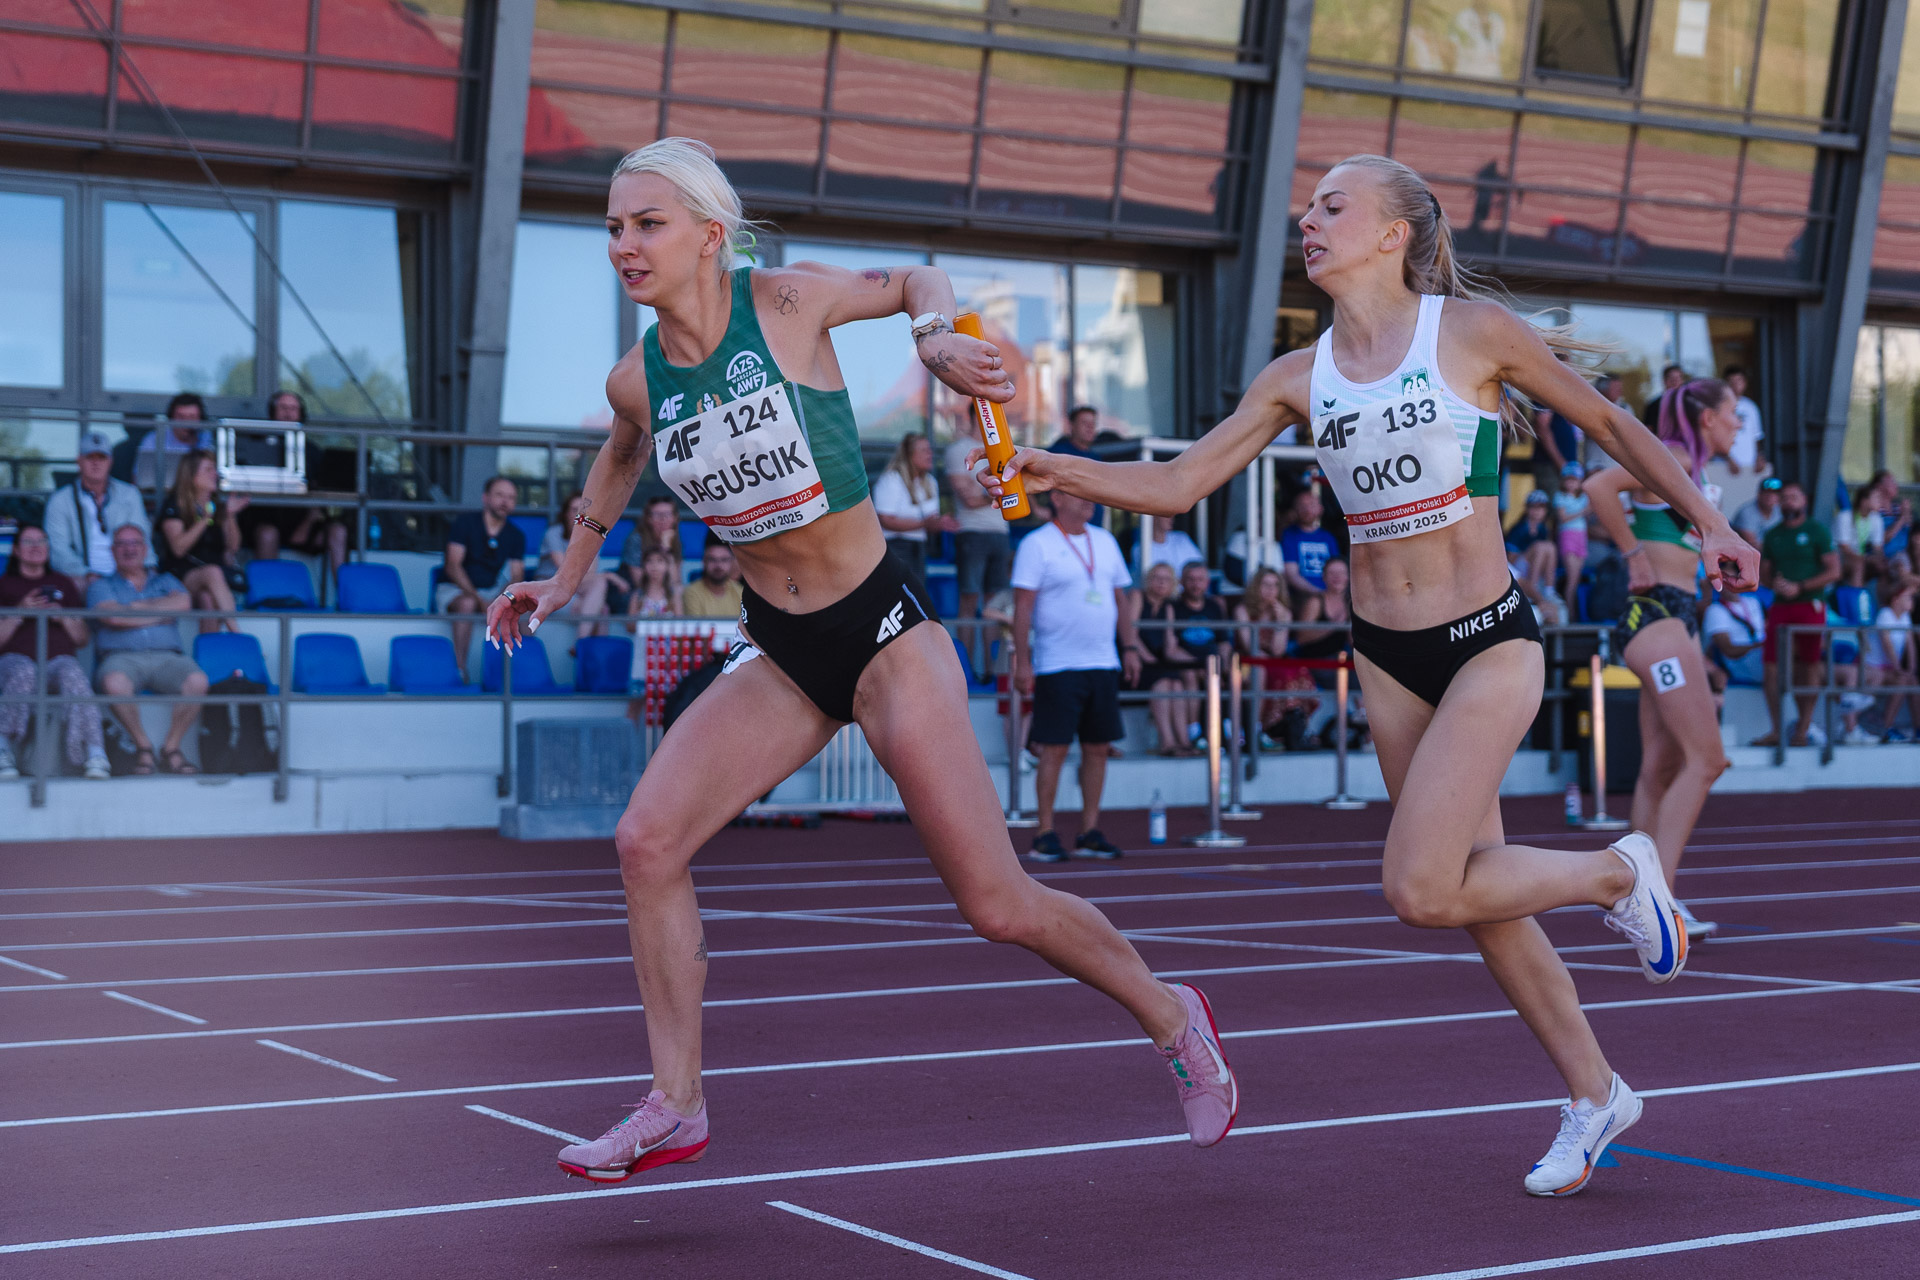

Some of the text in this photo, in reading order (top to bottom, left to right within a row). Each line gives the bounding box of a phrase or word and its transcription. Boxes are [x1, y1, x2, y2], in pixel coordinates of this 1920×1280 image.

[731, 367, 761, 384] WARSZAWA
[733, 356, 755, 375] AZS
[737, 376, 761, 396] AWF
[658, 393, 684, 421] 4F
[723, 397, 778, 438] 124
[1382, 398, 1437, 433] 133
[665, 421, 702, 462] 4F
[1317, 411, 1360, 450] 4F
[679, 440, 808, 504] JAGUŚCIK
[1352, 453, 1422, 494] OKO
[732, 503, 776, 524] Mistrzostwa
[776, 497, 796, 509] Polski
[796, 490, 813, 502] U23
[1359, 514, 1373, 523] PZLA
[1373, 505, 1416, 520] Mistrzostwa
[1417, 498, 1442, 511] Polski
[1443, 491, 1457, 503] U23
[728, 511, 803, 538] KRAKÓW 2025
[1364, 512, 1447, 539] KRAKÓW 2025
[876, 600, 905, 643] 4F
[1449, 610, 1495, 642] NIKE
[1658, 663, 1676, 686] 8
